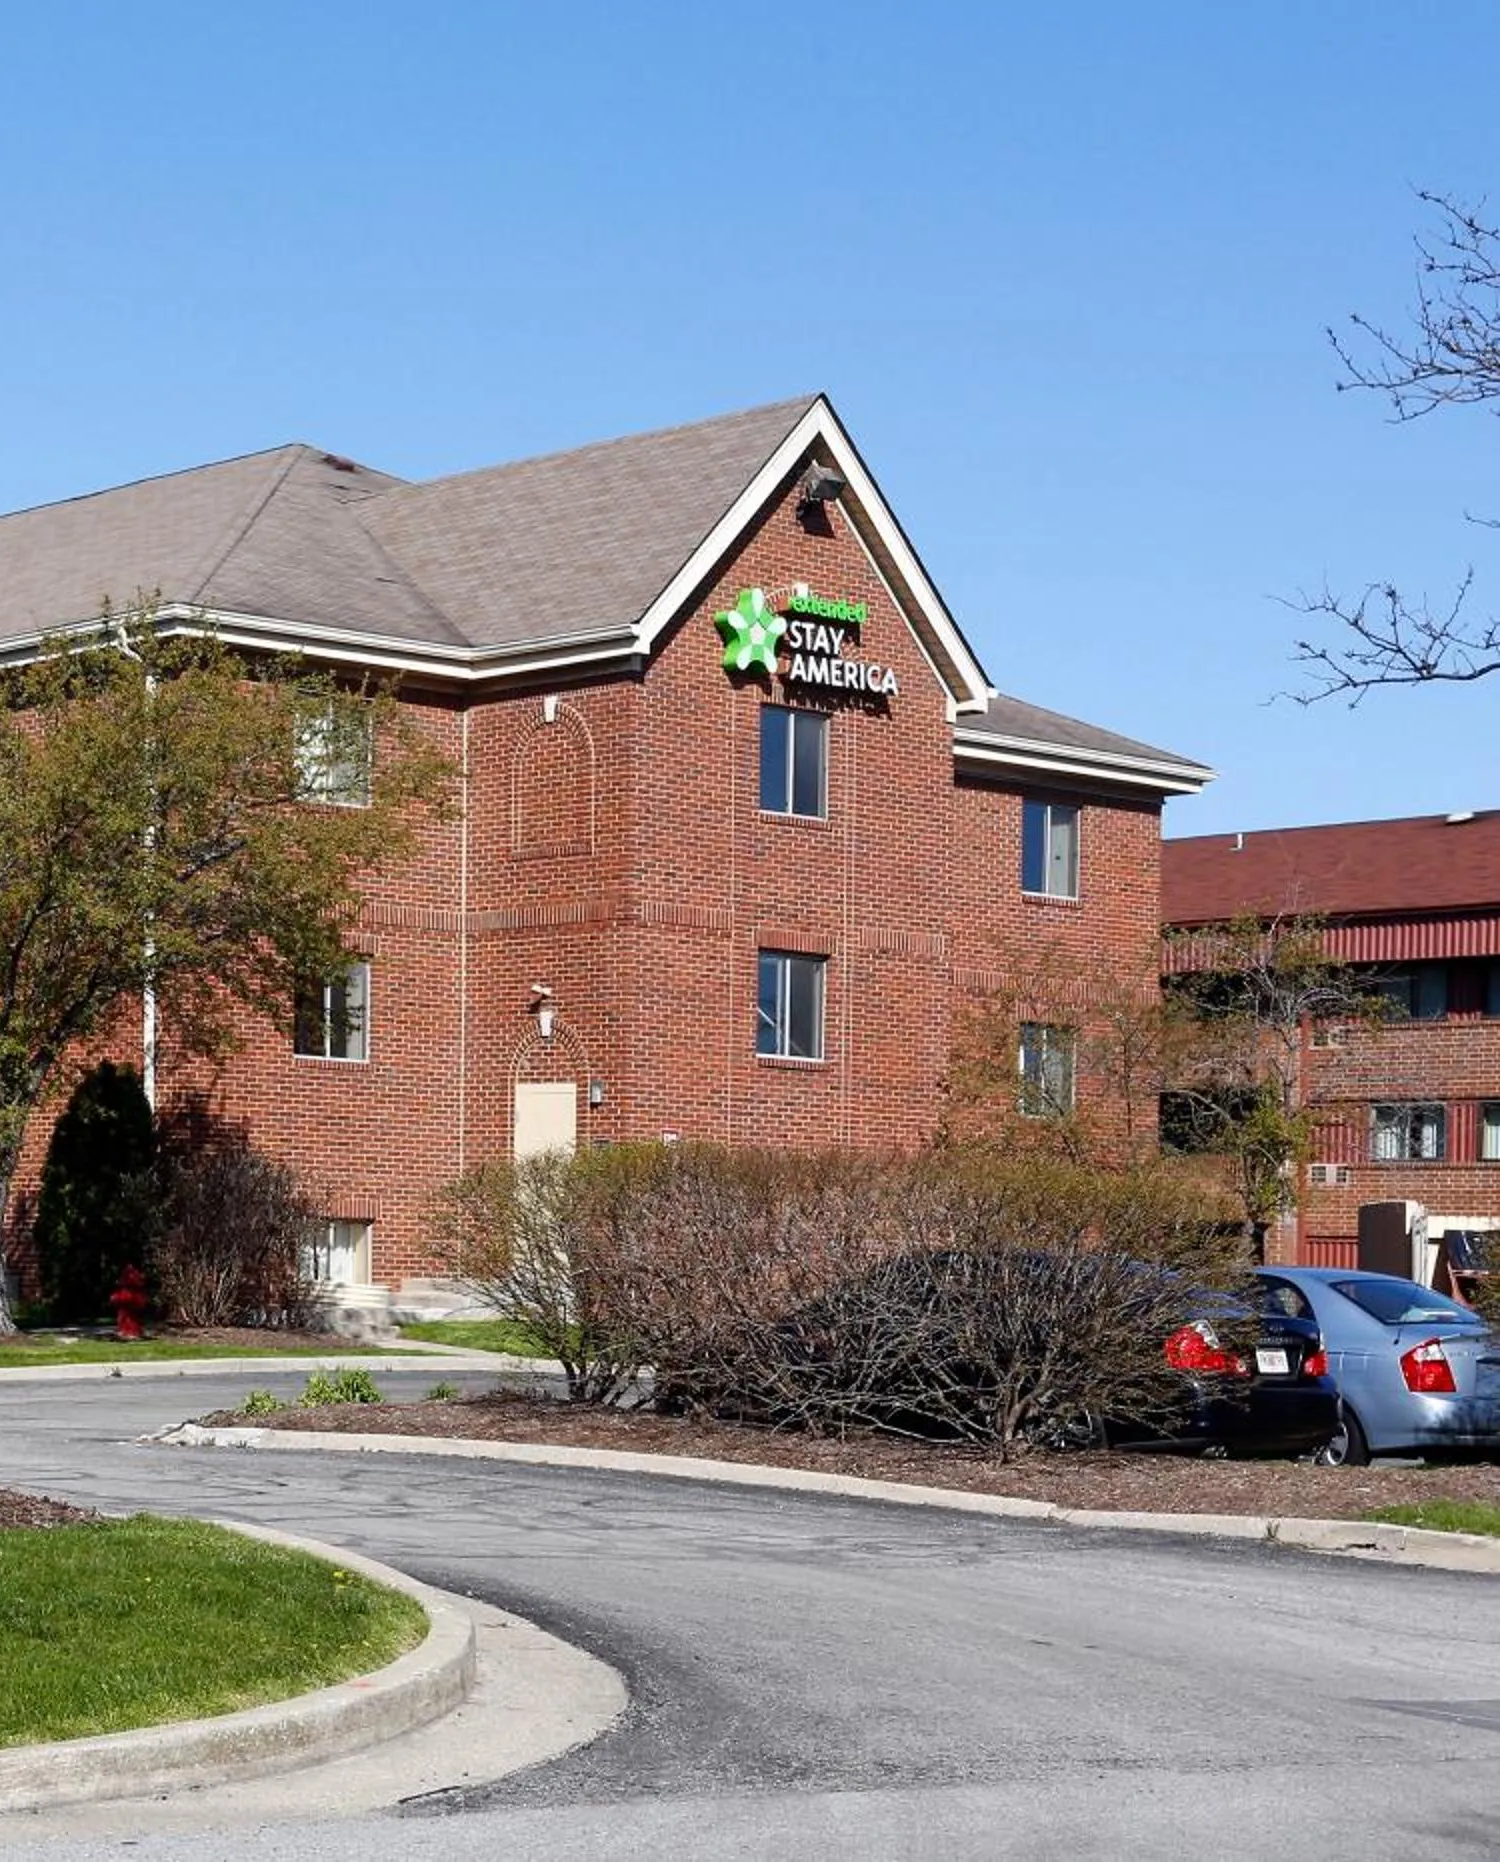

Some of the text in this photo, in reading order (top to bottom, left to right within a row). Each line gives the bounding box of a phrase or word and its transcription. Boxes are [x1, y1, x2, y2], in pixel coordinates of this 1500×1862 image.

[790, 597, 868, 622] extended
[789, 620, 845, 655] STAY
[790, 654, 899, 696] AMERICA
